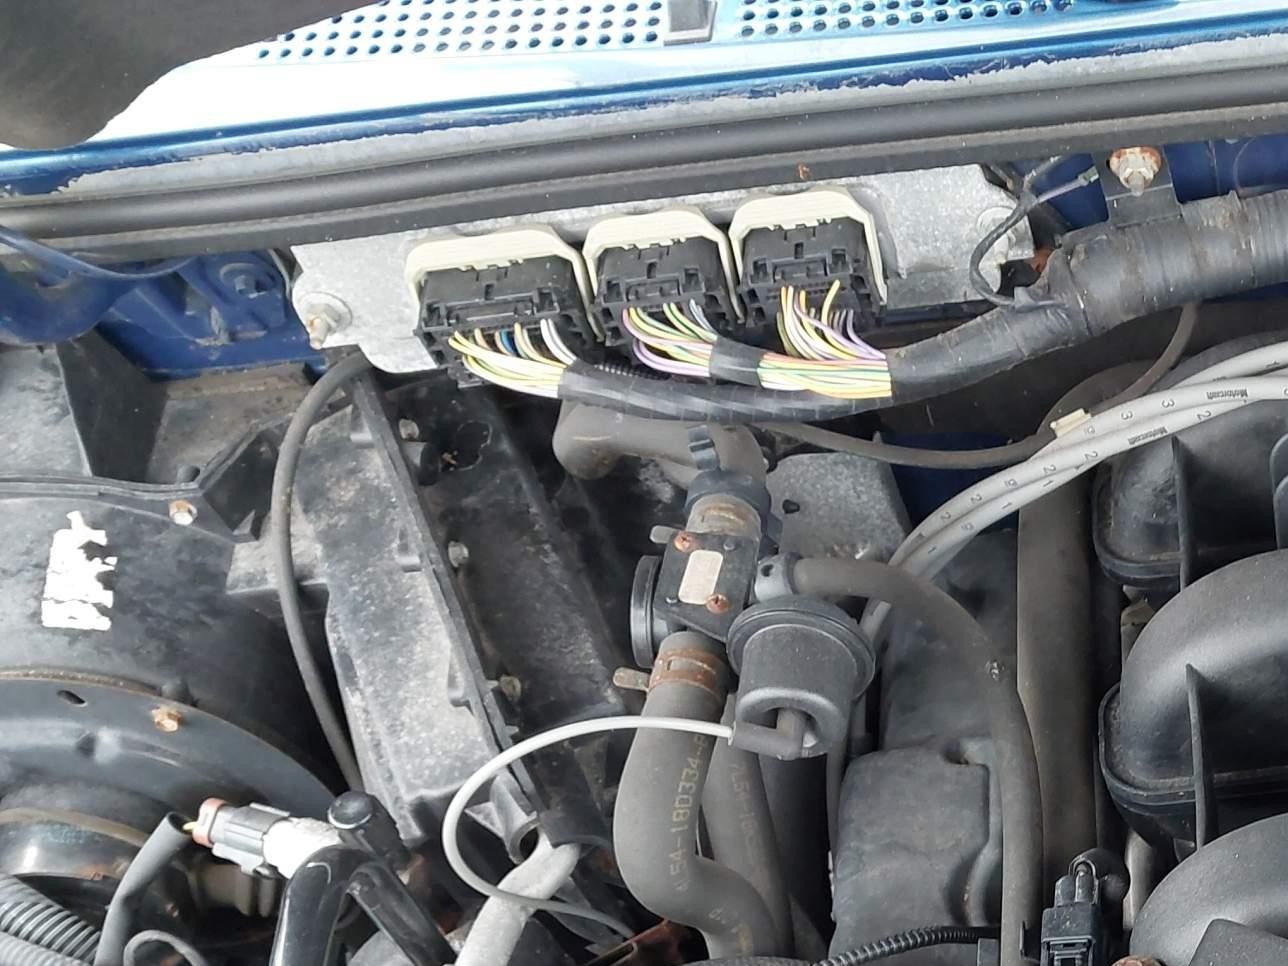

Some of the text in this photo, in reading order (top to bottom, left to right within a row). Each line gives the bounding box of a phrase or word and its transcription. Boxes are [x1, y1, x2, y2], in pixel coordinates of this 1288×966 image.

[1206, 387, 1249, 401] Motorcraft
[1162, 398, 1175, 409] 3
[1121, 410, 1134, 421] 3
[1197, 409, 1212, 421] 2
[1127, 426, 1169, 446] Motorcraft
[1084, 450, 1099, 461] 2
[1043, 463, 1057, 474] 2
